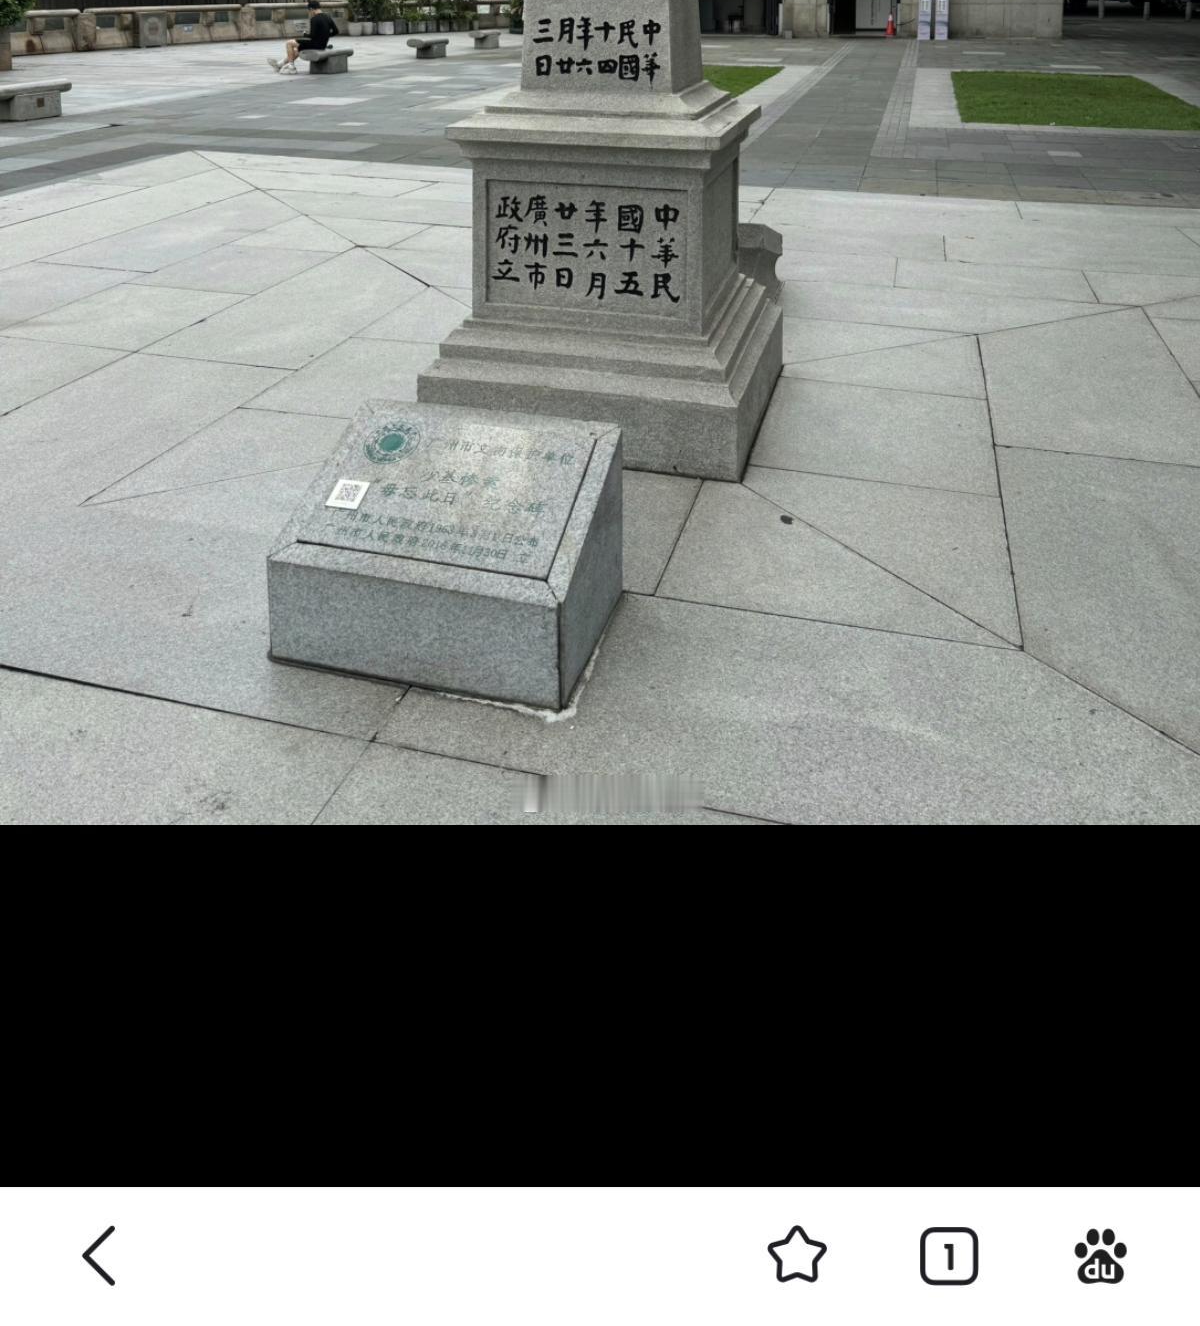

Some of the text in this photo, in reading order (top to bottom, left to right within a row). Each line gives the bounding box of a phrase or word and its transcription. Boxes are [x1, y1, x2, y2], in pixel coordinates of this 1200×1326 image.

[492, 196, 523, 282] 政府立
[524, 195, 548, 290] 廣州市
[553, 202, 578, 288] 廿三日
[583, 200, 608, 299] 年六月
[614, 204, 645, 296] 國十五
[651, 204, 680, 303] 中華民
[944, 1244, 954, 1271] 1
